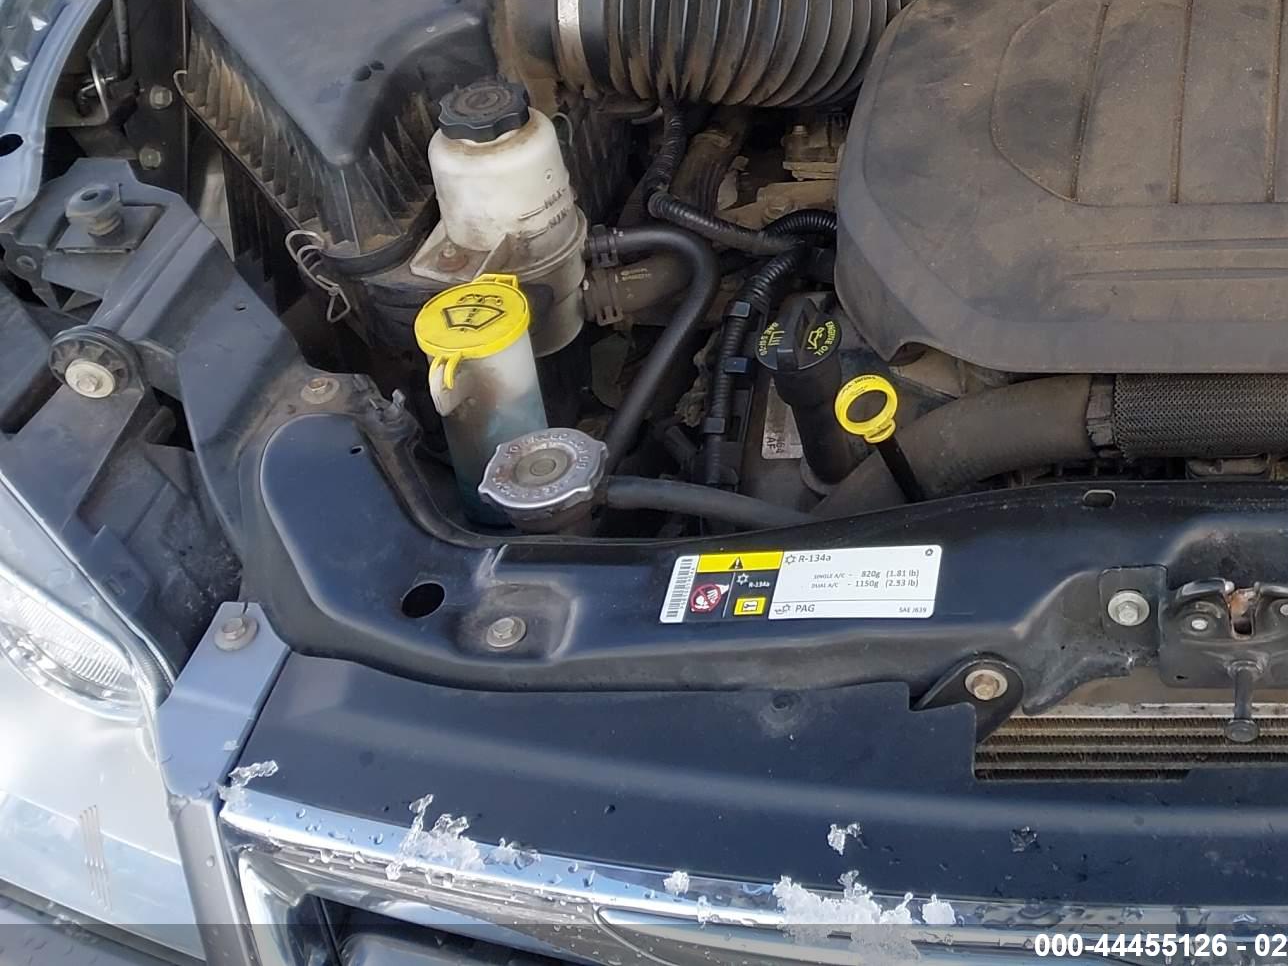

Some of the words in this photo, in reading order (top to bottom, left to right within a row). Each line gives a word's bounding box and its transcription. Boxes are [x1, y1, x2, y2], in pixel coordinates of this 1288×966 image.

[824, 321, 837, 345] ENGINE
[814, 346, 829, 356] OIL
[797, 554, 832, 563] R-134a
[861, 570, 881, 579] 820g
[886, 570, 907, 579] (1.81
[908, 569, 920, 578] lb)
[855, 580, 880, 589] 1150g
[885, 579, 906, 589] (2.53
[906, 579, 919, 588] lb)
[795, 604, 816, 613] PAG
